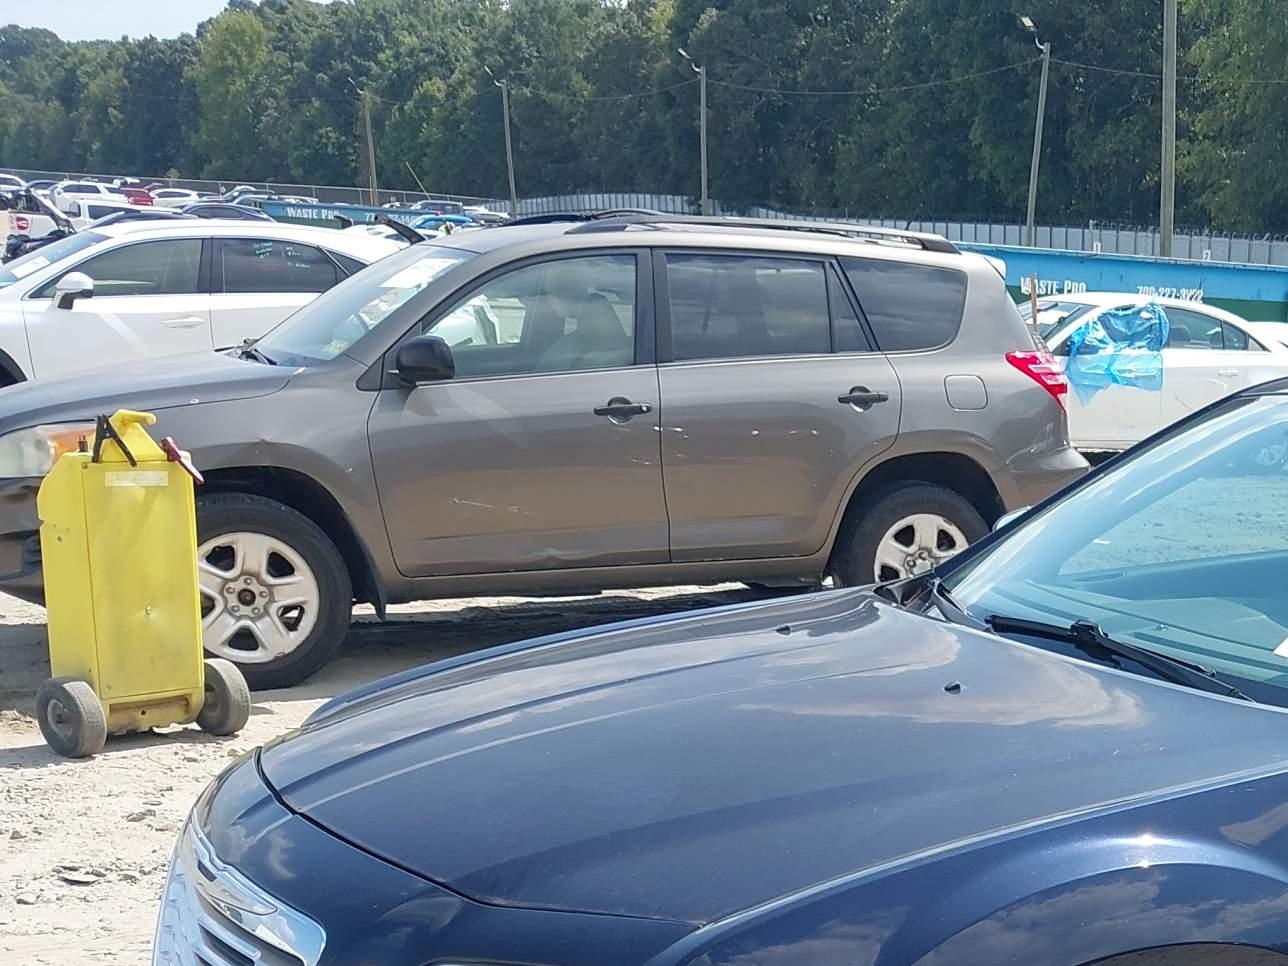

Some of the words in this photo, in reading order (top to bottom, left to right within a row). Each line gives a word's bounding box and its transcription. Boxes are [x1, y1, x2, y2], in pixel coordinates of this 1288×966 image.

[286, 207, 318, 219] WASTE
[1020, 277, 1060, 296] WASTE
[1064, 280, 1088, 294] PRO
